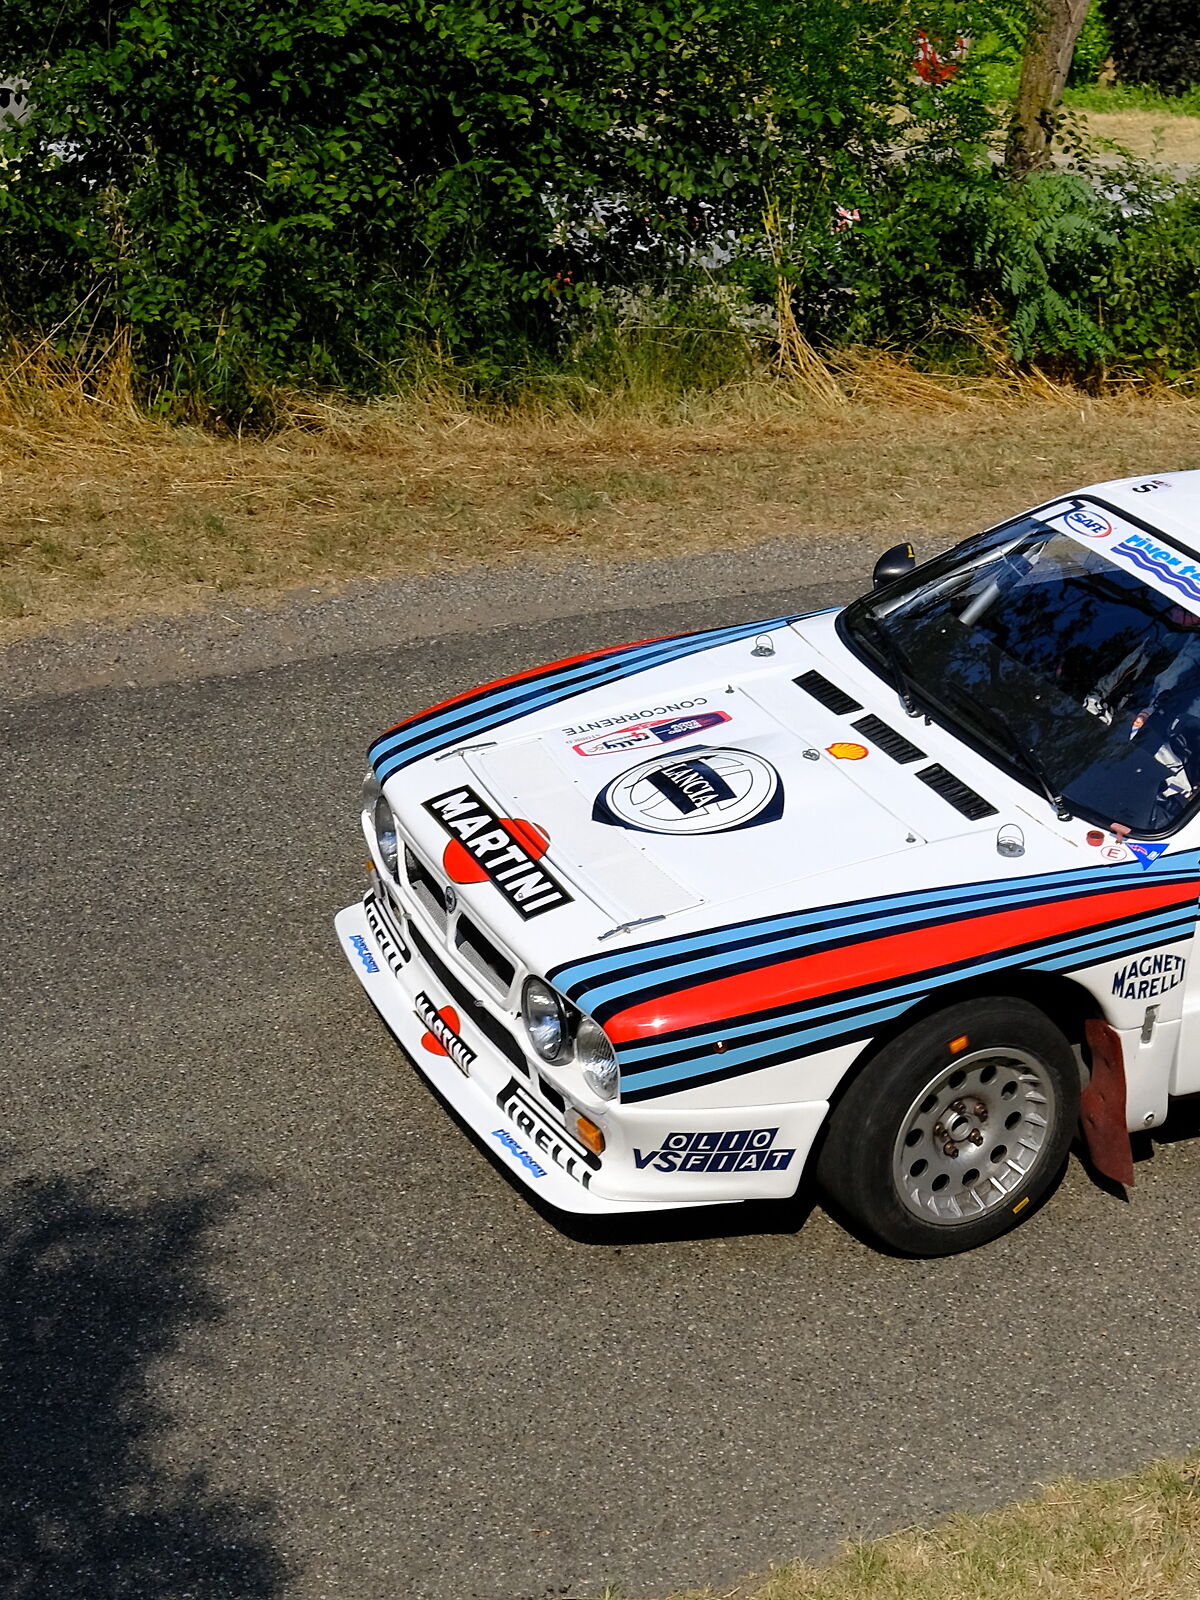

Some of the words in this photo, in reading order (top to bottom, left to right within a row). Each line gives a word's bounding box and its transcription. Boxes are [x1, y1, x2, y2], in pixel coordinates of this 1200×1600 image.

[1069, 513, 1107, 533] SAFE
[1125, 534, 1179, 567] river
[562, 697, 707, 736] CONCORRENTE
[661, 762, 722, 809] LANCIA
[432, 791, 562, 912] MARTINI
[1107, 848, 1121, 859] E
[416, 993, 476, 1077] MARTINI
[496, 1077, 602, 1190] PIRELLI
[666, 1130, 774, 1150] OLIO
[686, 1152, 790, 1171] FIAT
